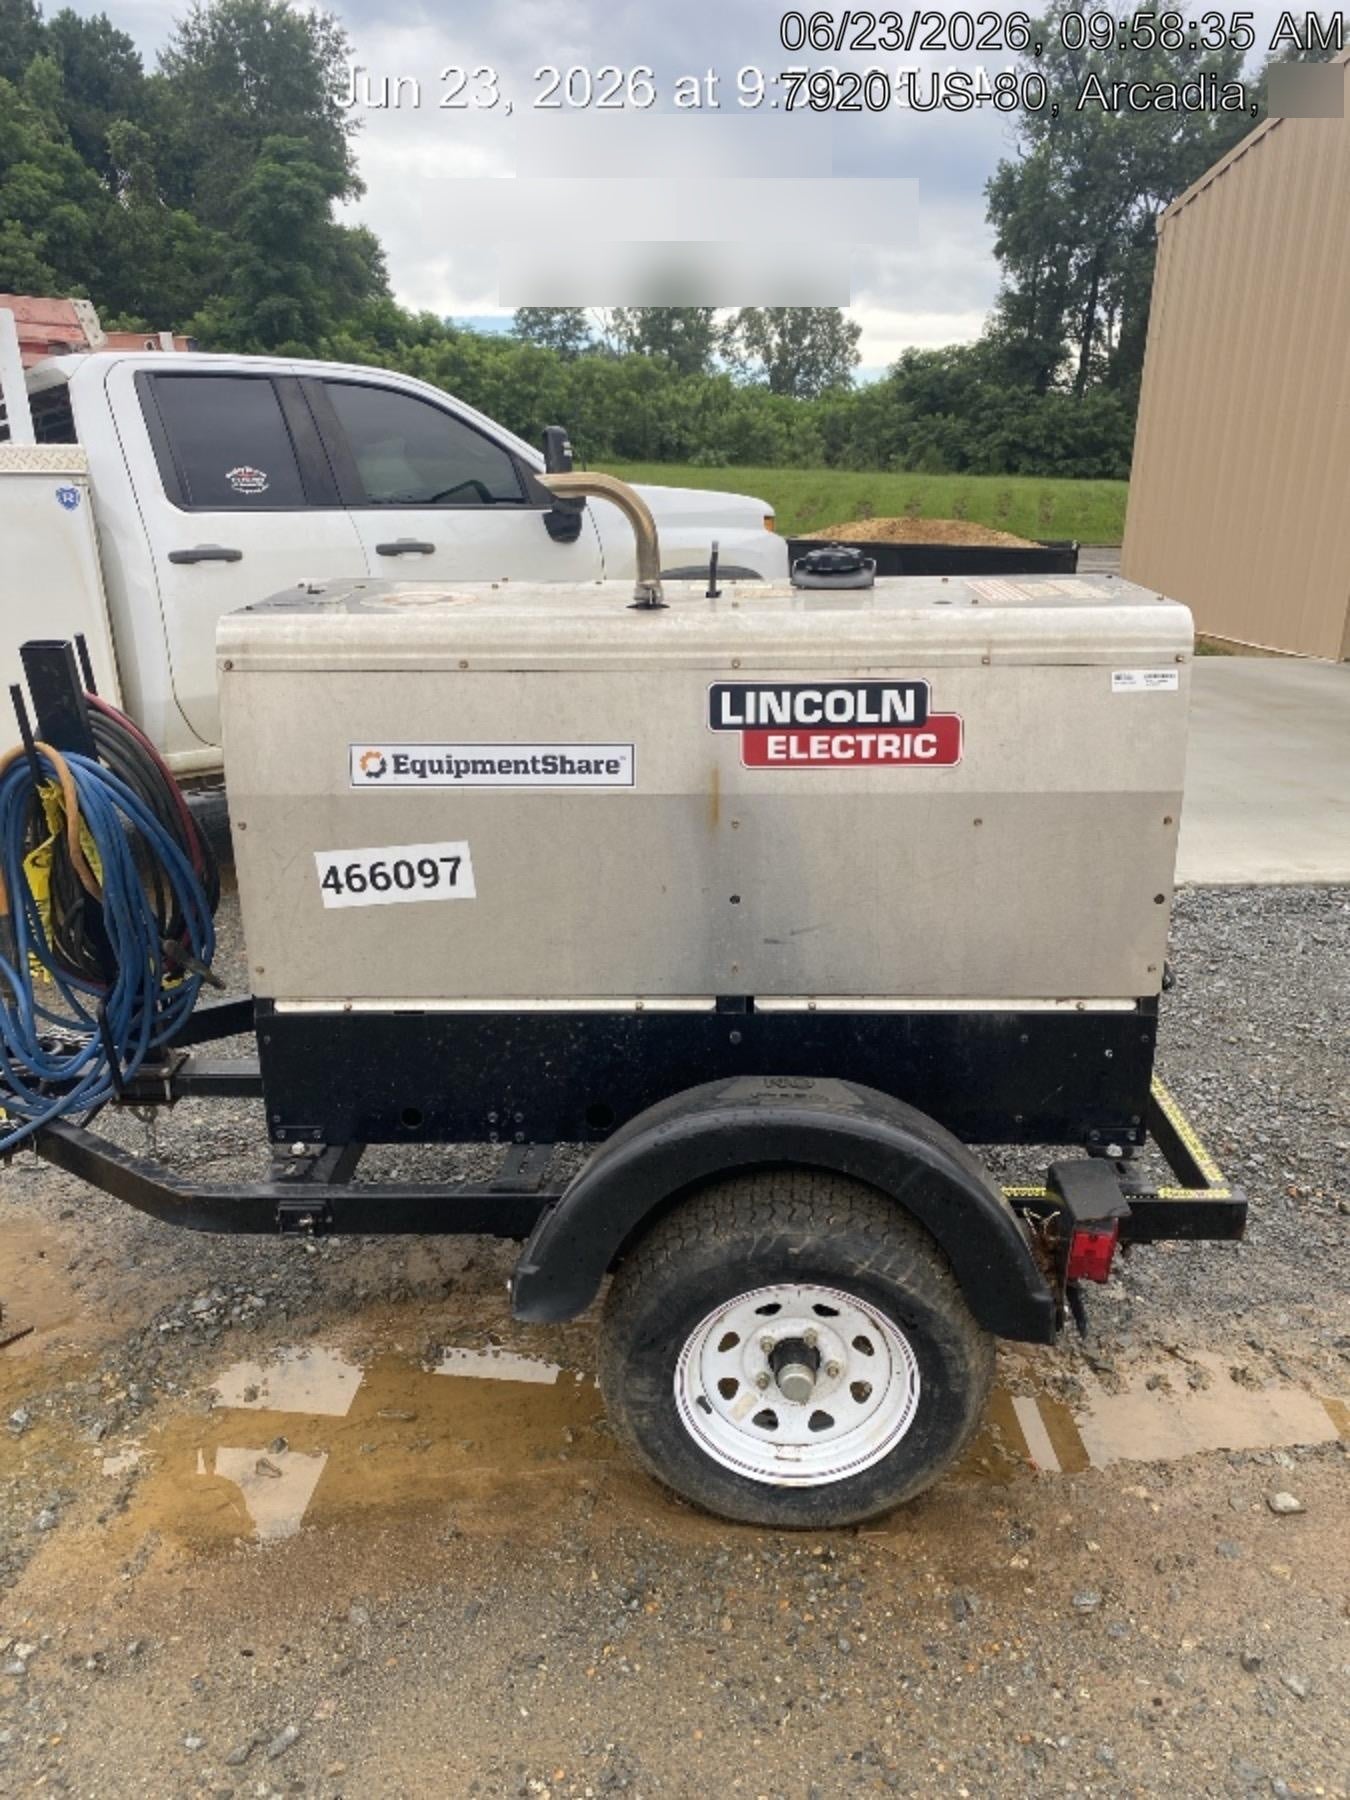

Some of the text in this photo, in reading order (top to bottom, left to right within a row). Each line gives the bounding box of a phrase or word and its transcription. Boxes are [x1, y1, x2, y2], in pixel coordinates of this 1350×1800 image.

[721, 689, 916, 725] LINCOLN
[767, 732, 938, 760] ELECTRIC
[392, 754, 621, 779] EquipmentShare
[321, 856, 462, 895] 466097
